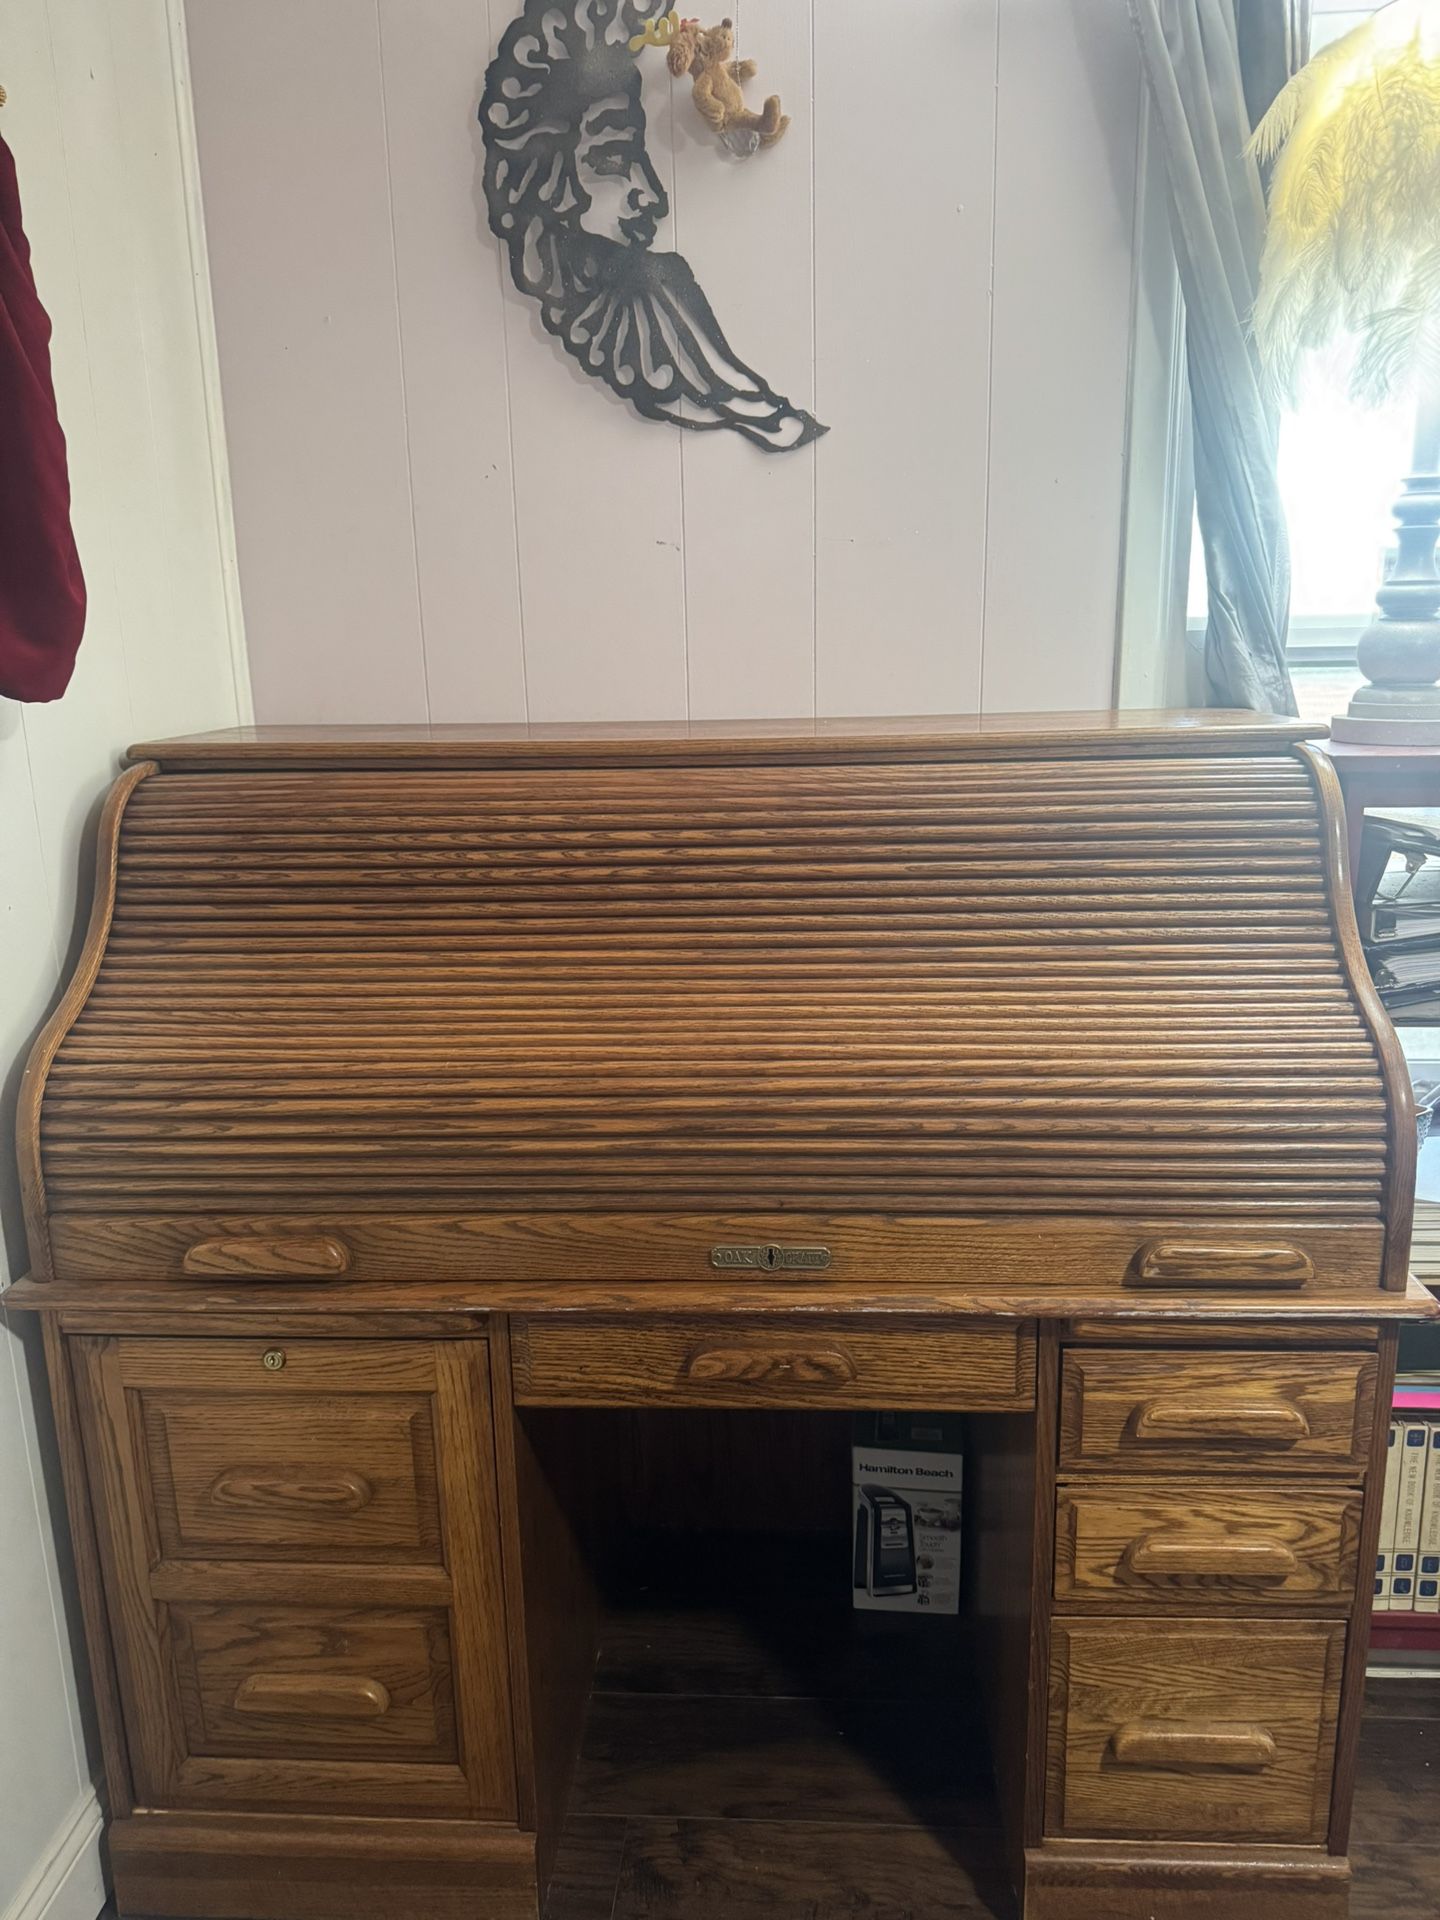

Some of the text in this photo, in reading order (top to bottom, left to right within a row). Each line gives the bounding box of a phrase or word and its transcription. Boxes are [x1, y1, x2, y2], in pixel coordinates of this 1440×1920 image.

[724, 1250, 753, 1264] OAK
[858, 1462, 954, 1479] Hamilton Beach
[1402, 1452, 1419, 1545] THE NEW BOOK OF KNOWLEDGE
[1428, 1511, 1439, 1546] KNOWLEDGE
